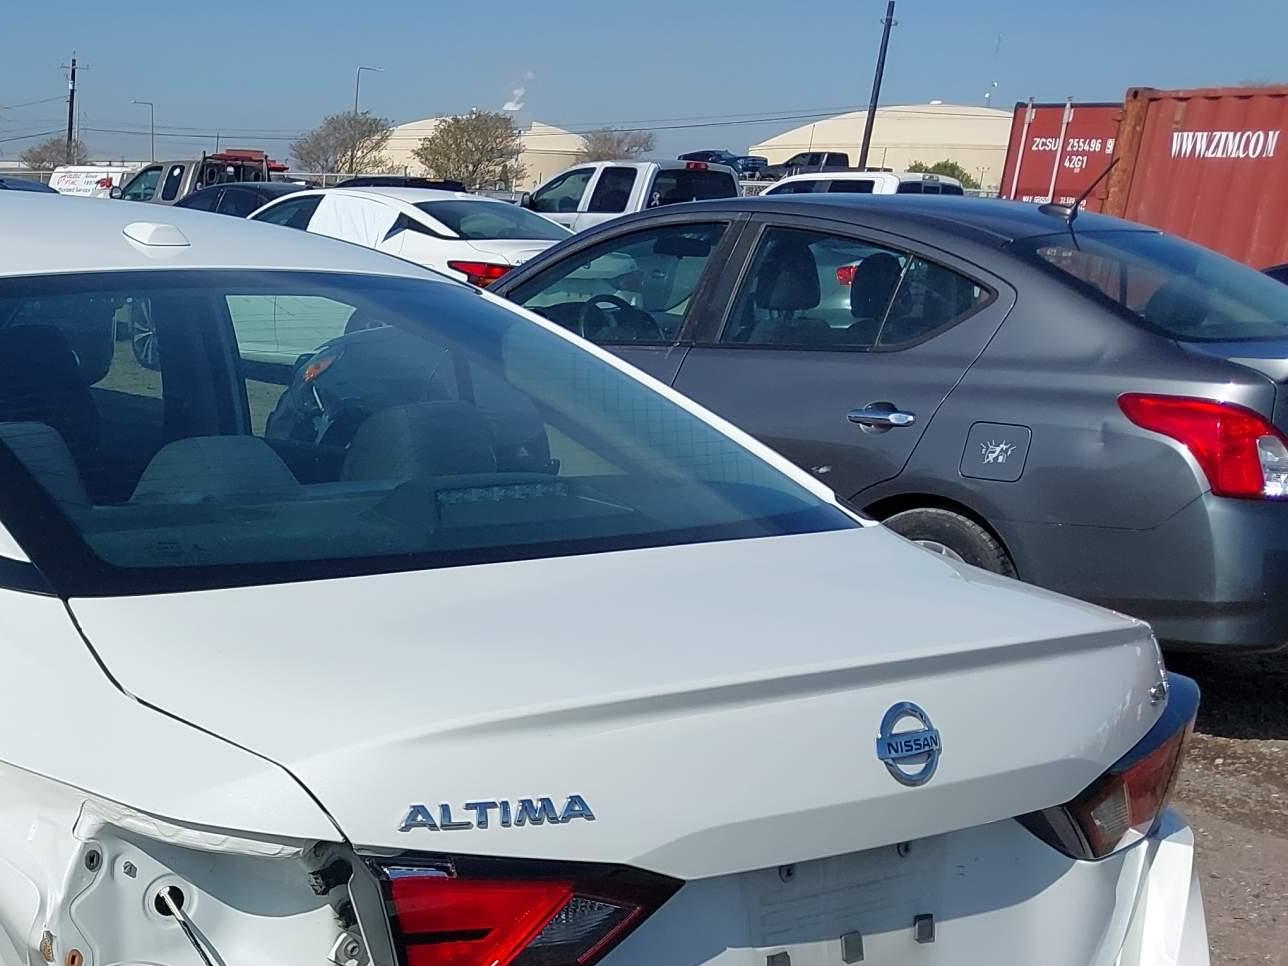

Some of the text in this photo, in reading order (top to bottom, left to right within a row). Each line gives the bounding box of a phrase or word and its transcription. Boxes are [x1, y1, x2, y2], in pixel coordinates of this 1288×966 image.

[1032, 138, 1059, 151] ZCSU
[1066, 138, 1101, 151] 255496
[1064, 156, 1087, 168] 42G1
[887, 735, 938, 755] NISSAN
[398, 794, 596, 832] ALTIMA
